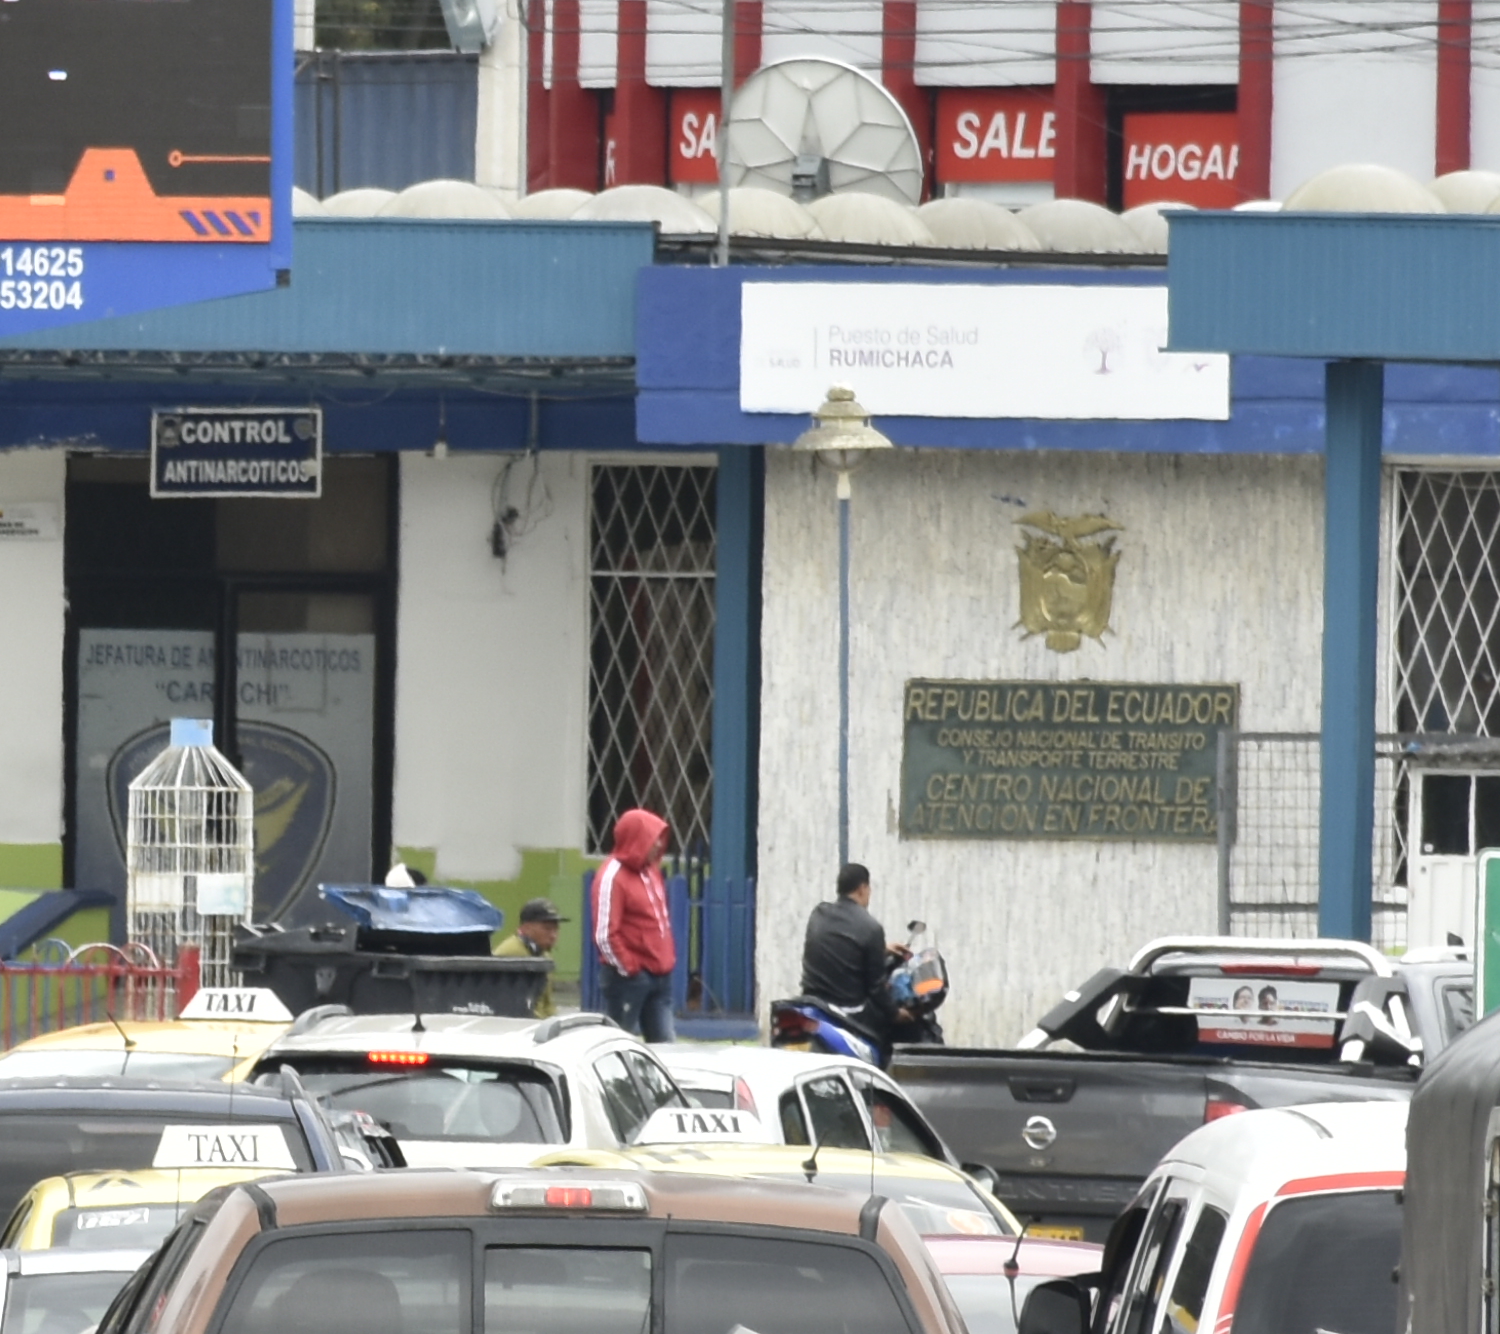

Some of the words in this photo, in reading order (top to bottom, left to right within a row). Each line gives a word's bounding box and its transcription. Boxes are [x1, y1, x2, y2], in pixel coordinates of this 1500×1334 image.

[680, 111, 720, 159] SA
[952, 111, 1057, 160] SALE
[828, 325, 891, 347] Puesto
[897, 325, 922, 347] de
[927, 325, 980, 347] Salud
[828, 348, 955, 369] RUMICHACA
[181, 419, 293, 445] CONTROL
[162, 458, 310, 484] ANTINARCOTICOS
[85, 644, 166, 668] JEFATURA
[170, 645, 193, 668] DE
[906, 687, 1046, 721] REPUBLICA
[1052, 689, 1101, 724] DEL
[1106, 690, 1233, 725] ECUADOR
[937, 727, 1013, 748] CONSEJO
[1016, 728, 1098, 750] NACIONAL
[1100, 730, 1123, 750] DE
[1127, 731, 1206, 751] TRANSITO
[961, 749, 975, 766] Y
[977, 749, 1084, 768] TRANSPORTE
[1088, 750, 1182, 771] TERRESTRE
[925, 773, 1033, 803] CENTRO
[1038, 774, 1165, 804] NACIONAL
[1173, 776, 1212, 806] DE
[909, 802, 1040, 833] ATENCION
[1043, 804, 1081, 834] EN
[204, 992, 258, 1014] TAXI
[668, 1111, 744, 1136] TAXI
[187, 1133, 260, 1164] TAXI
